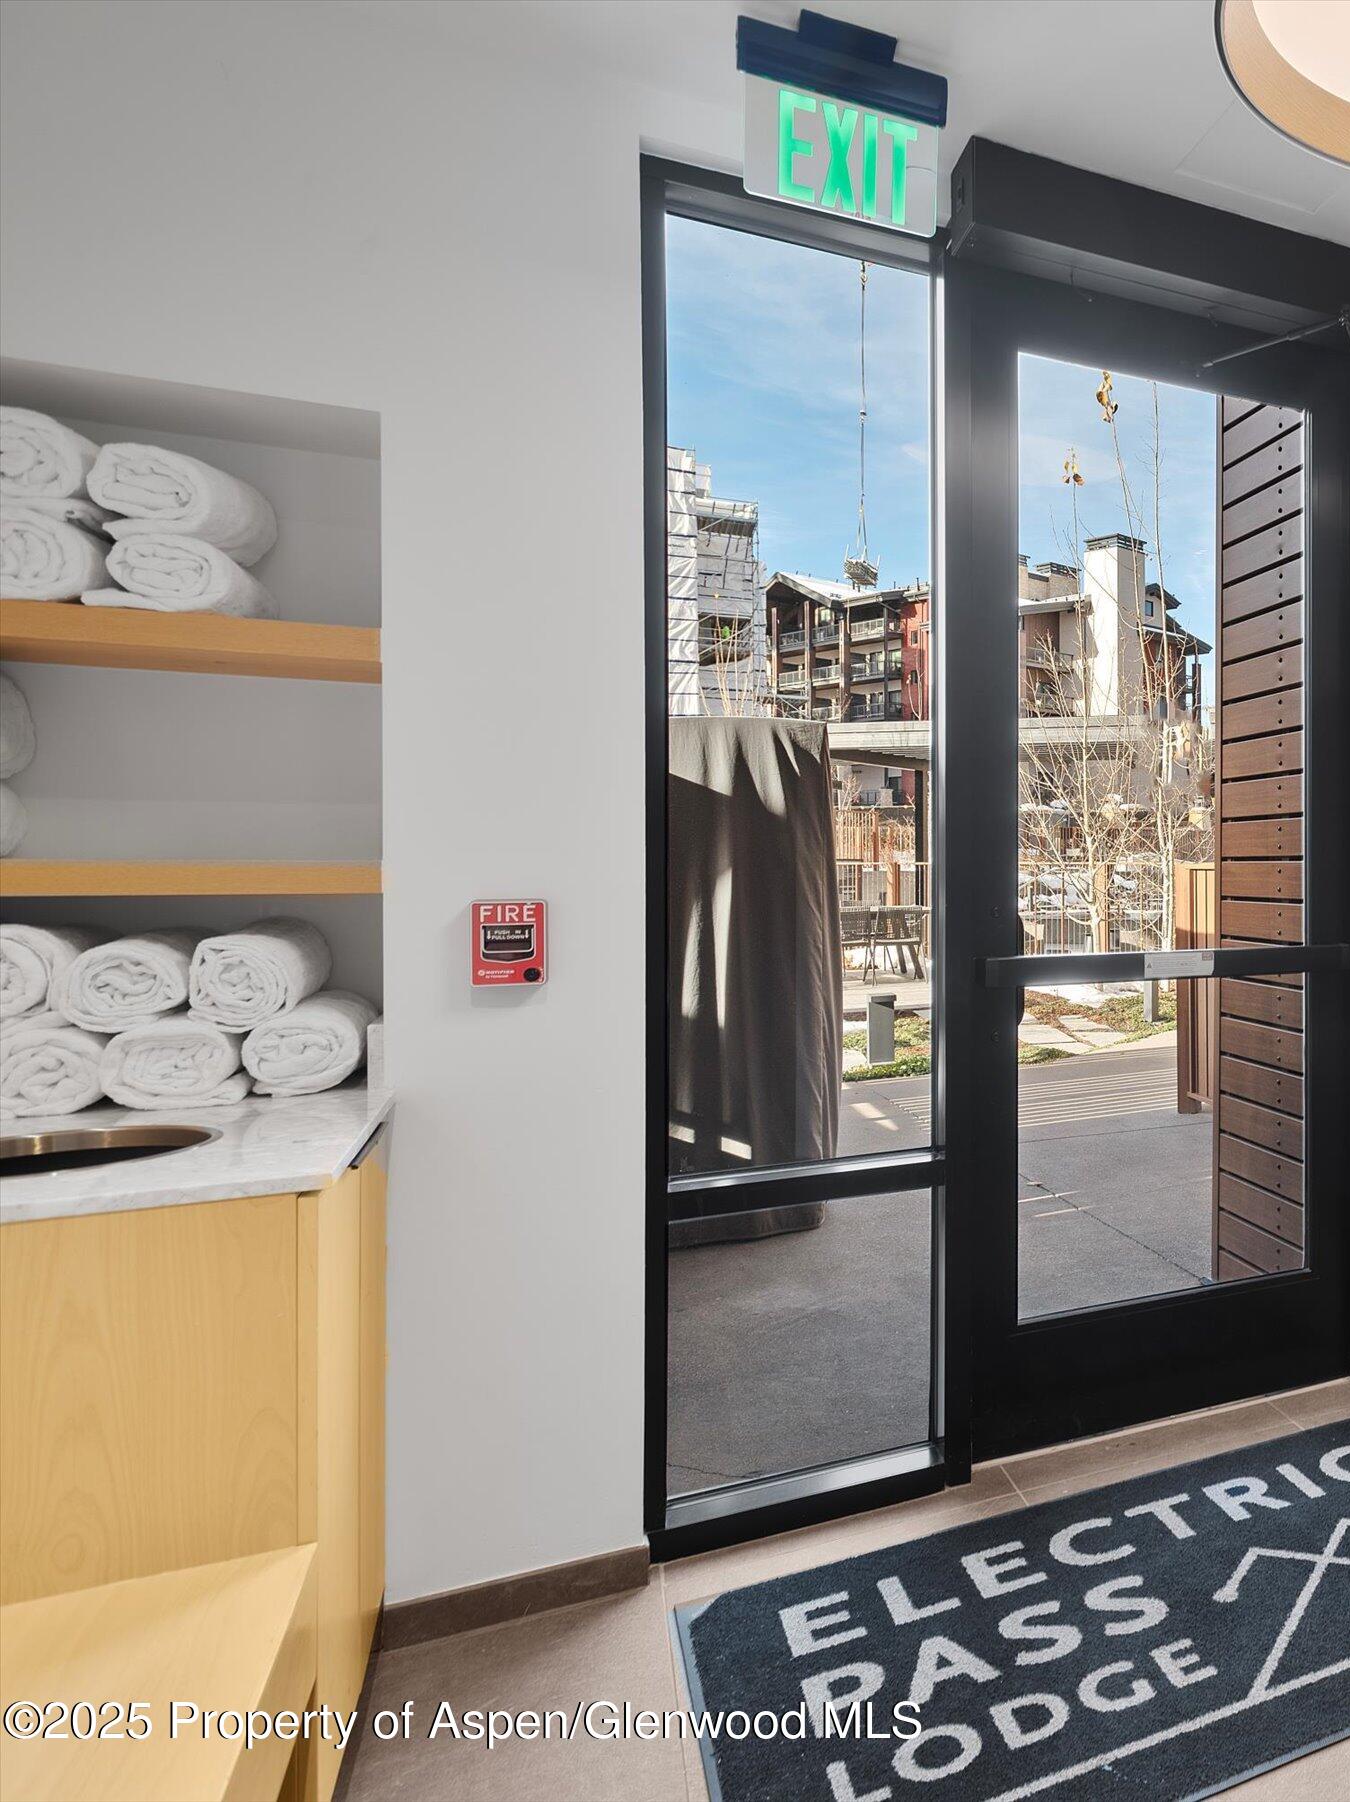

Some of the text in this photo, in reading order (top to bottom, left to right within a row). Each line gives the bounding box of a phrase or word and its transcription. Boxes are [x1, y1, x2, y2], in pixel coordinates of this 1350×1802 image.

[778, 88, 918, 226] EXIT
[480, 905, 536, 922] FIRE
[800, 1575, 1169, 1739] PASS
[826, 1638, 1218, 1802] LODGE
